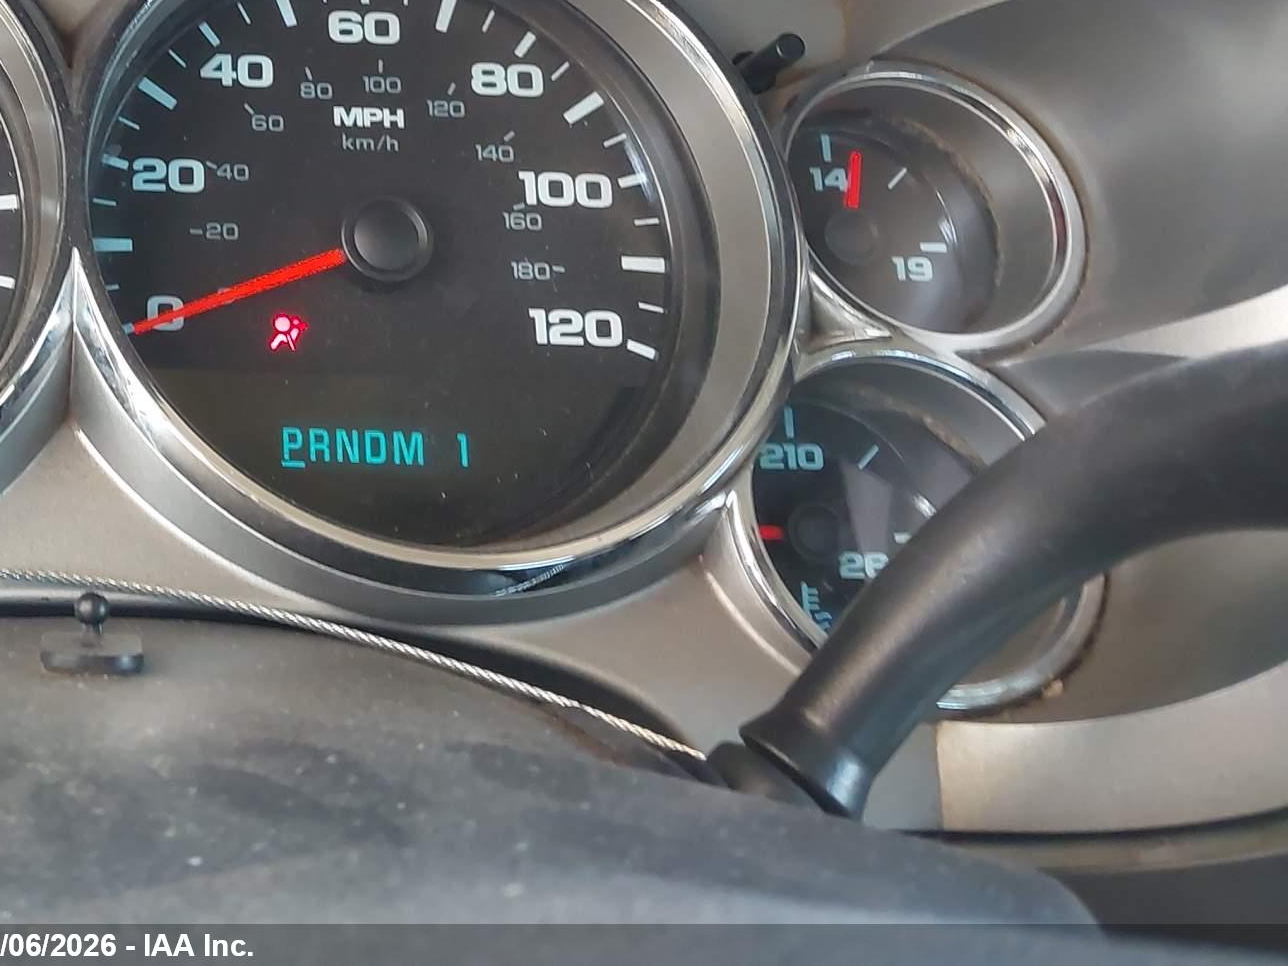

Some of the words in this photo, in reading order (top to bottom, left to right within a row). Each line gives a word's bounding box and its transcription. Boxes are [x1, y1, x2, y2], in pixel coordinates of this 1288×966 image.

[328, 11, 400, 45] 60
[200, 55, 274, 88] 40
[471, 63, 544, 98] 80
[301, 82, 333, 100] 80
[363, 75, 401, 94] 100
[333, 107, 405, 129] MPH
[427, 99, 465, 118] 120
[252, 115, 284, 132] 60
[342, 134, 399, 152] km/h
[476, 144, 514, 163] 140
[132, 158, 205, 193] 20
[216, 163, 250, 181] 40
[810, 167, 848, 192] 14
[518, 172, 612, 209] 100
[206, 222, 239, 240] 20
[503, 212, 542, 231] 160
[512, 261, 551, 280] 180
[892, 256, 934, 282] 19
[147, 295, 184, 331] 0
[528, 309, 623, 347] 120
[281, 426, 424, 468] PRNDM
[456, 433, 469, 468] 1
[758, 444, 824, 471] 210
